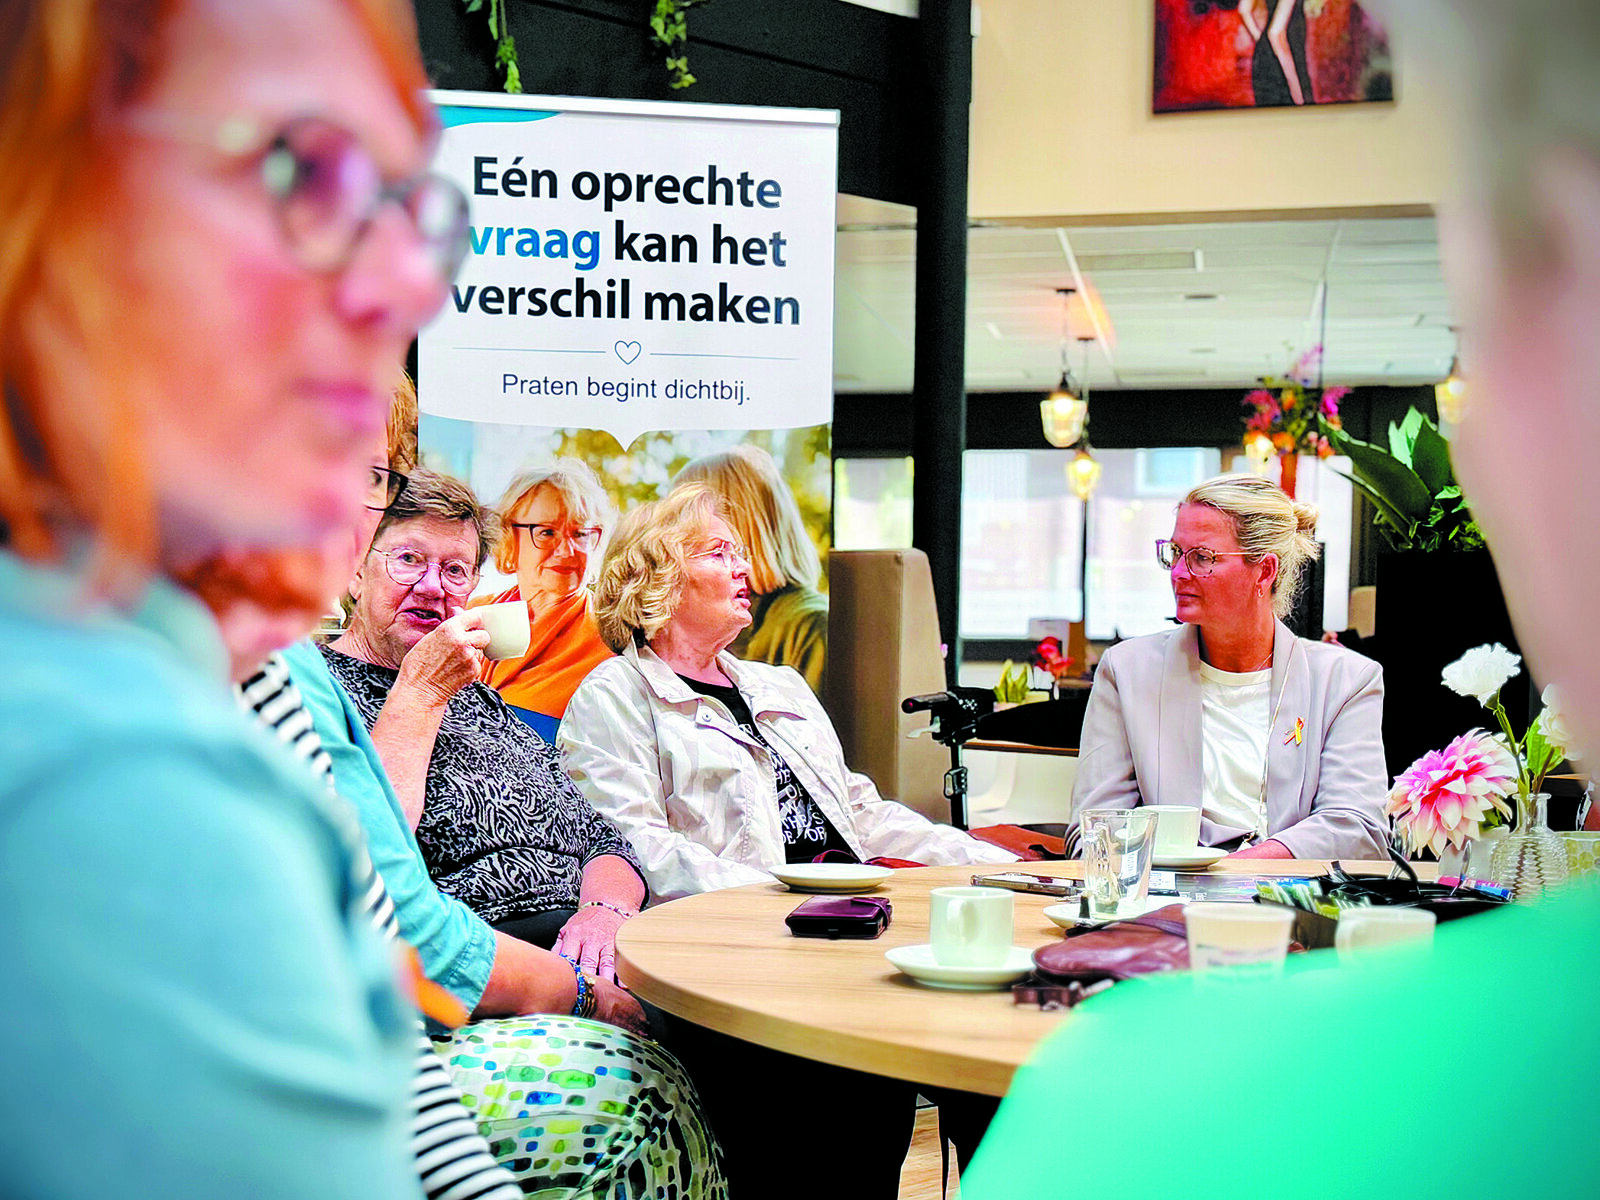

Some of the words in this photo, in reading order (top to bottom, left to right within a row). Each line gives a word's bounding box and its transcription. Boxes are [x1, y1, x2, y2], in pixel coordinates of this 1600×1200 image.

[473, 155, 558, 199] Eén
[571, 164, 782, 213] oprechte
[469, 225, 601, 271] vraag
[614, 219, 698, 264] kan
[712, 223, 787, 268] het
[452, 277, 631, 320] verschil
[644, 281, 800, 326] maken
[502, 373, 578, 396] Praten
[587, 376, 658, 403] begint
[664, 378, 751, 406] dichtbij.
